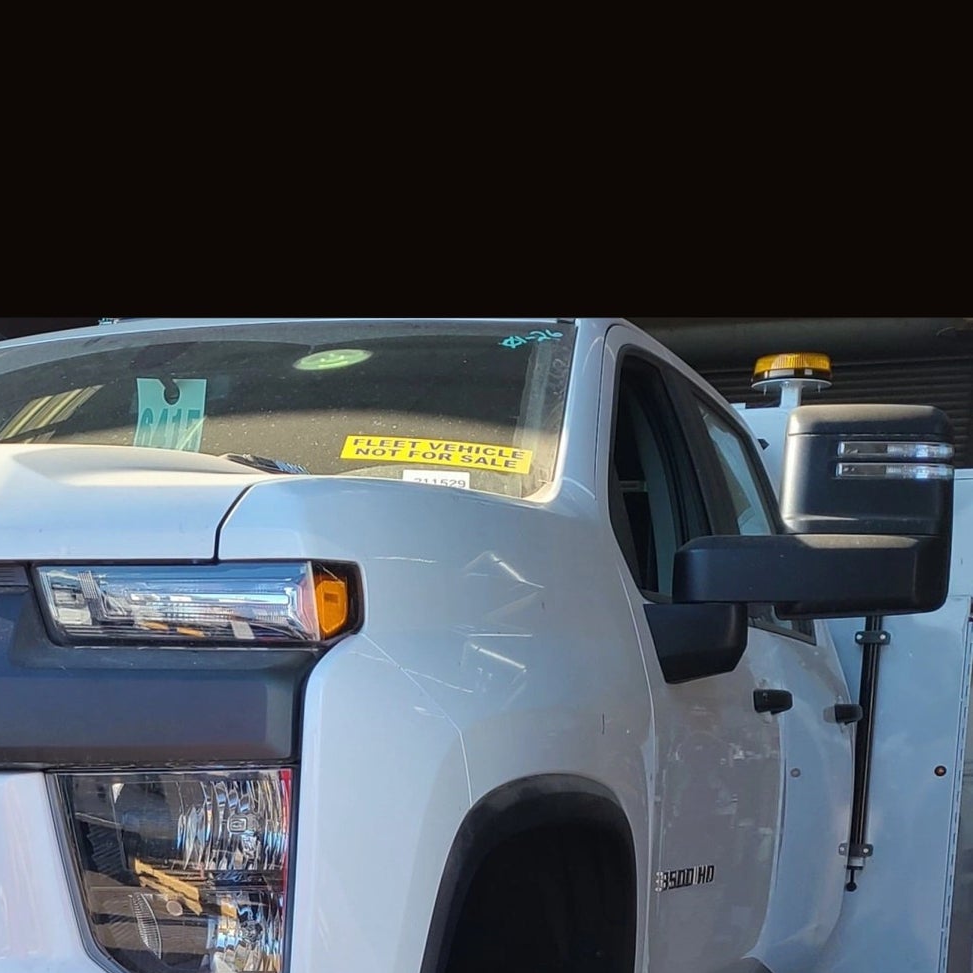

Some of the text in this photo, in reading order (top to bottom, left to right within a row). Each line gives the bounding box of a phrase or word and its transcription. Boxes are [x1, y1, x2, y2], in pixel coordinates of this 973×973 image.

[353, 438, 525, 459] FLEET VEHICLE
[355, 448, 517, 469] NOT FOR SALE
[697, 864, 715, 884] HD
